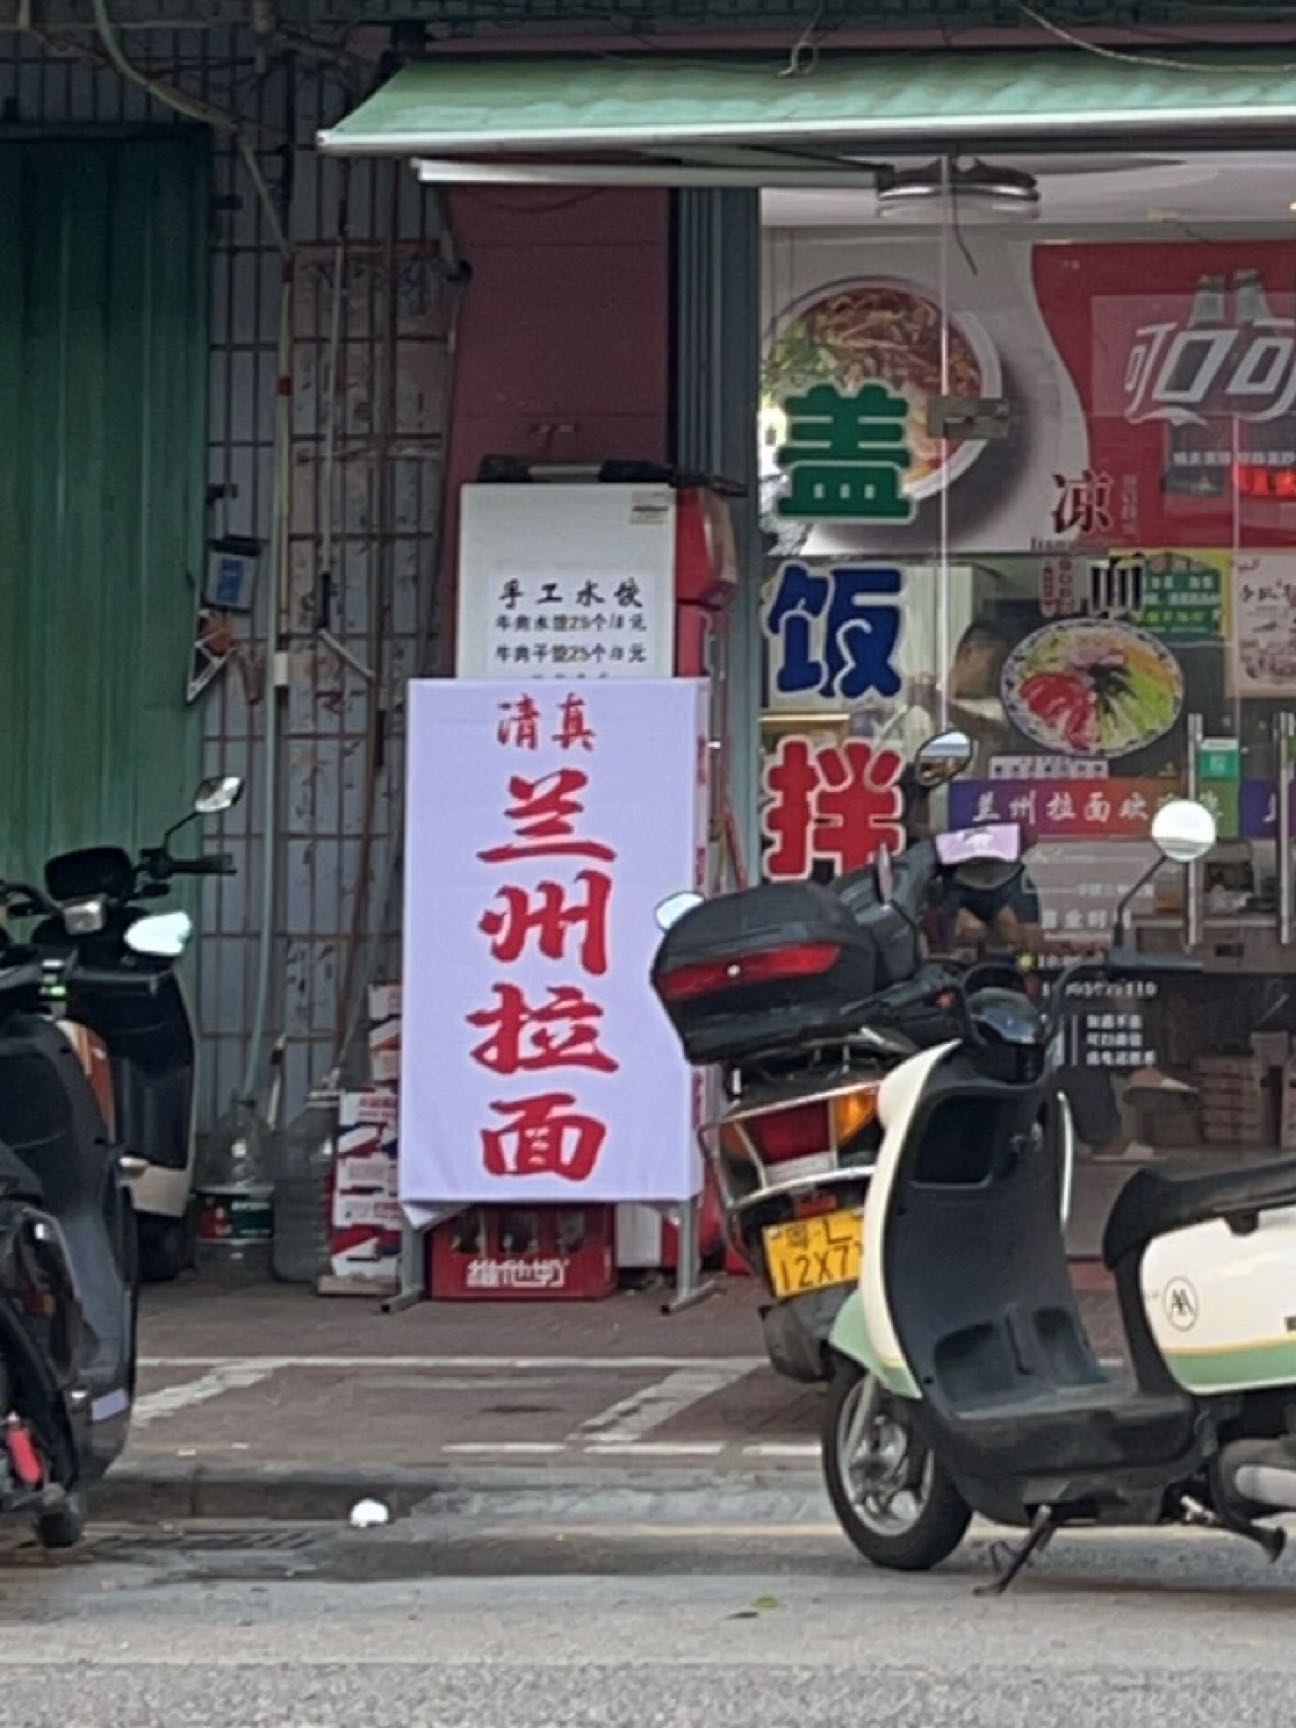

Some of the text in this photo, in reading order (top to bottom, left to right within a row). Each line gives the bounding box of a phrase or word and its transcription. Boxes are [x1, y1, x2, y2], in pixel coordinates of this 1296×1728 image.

[498, 576, 643, 611] 手工水饺
[496, 691, 598, 752] 清真
[464, 766, 621, 1184] 兰州拉面
[780, 1239, 864, 1290] 12X7
